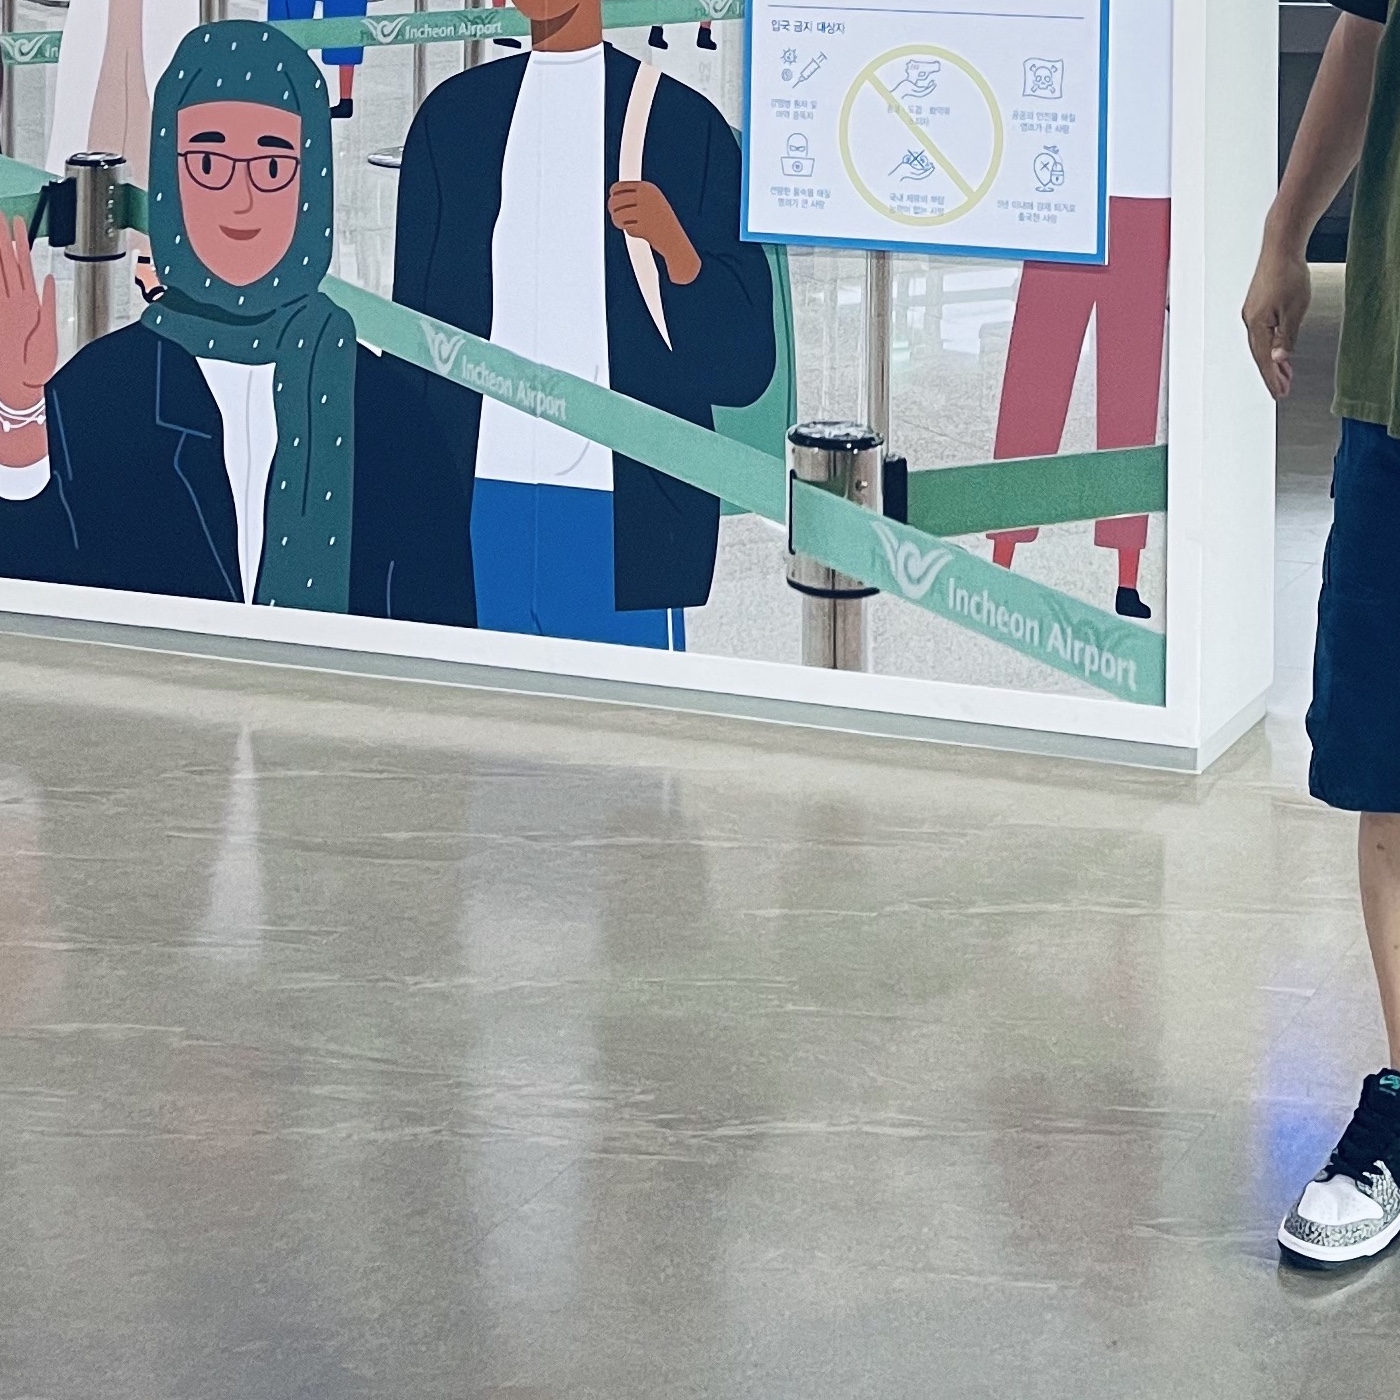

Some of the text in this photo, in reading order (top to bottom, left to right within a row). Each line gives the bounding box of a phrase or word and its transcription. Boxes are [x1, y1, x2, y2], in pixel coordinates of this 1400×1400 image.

[405, 21, 503, 40] Incheon Airport
[771, 19, 846, 35] 입국 금지 대상자
[462, 354, 567, 422] Incheon Airport
[946, 576, 1138, 693] Incheon Airport
